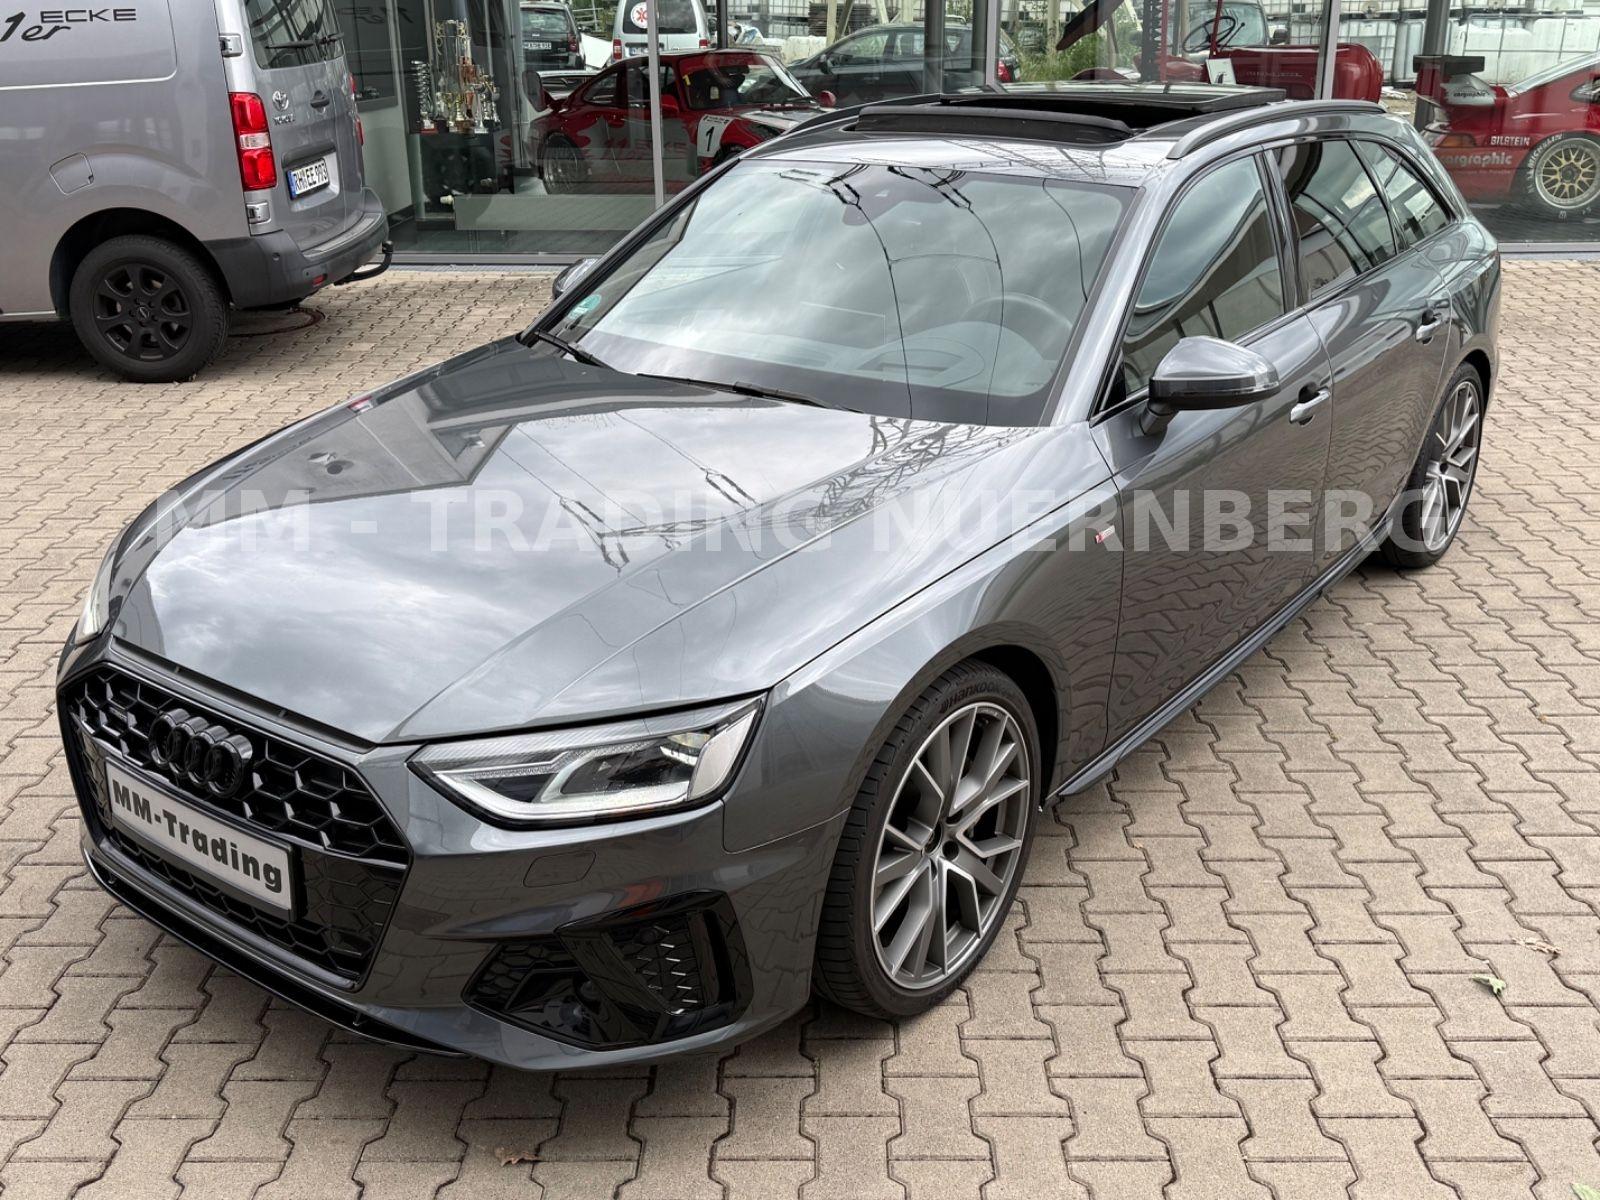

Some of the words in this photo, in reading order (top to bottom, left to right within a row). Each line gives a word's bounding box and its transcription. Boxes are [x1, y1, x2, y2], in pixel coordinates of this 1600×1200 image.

[40, 8, 137, 23] ECKE
[705, 126, 715, 152] 1
[1490, 136, 1531, 146] BILSTEIN
[1441, 152, 1513, 167] argraphic
[112, 778, 283, 894] MM-Trading
